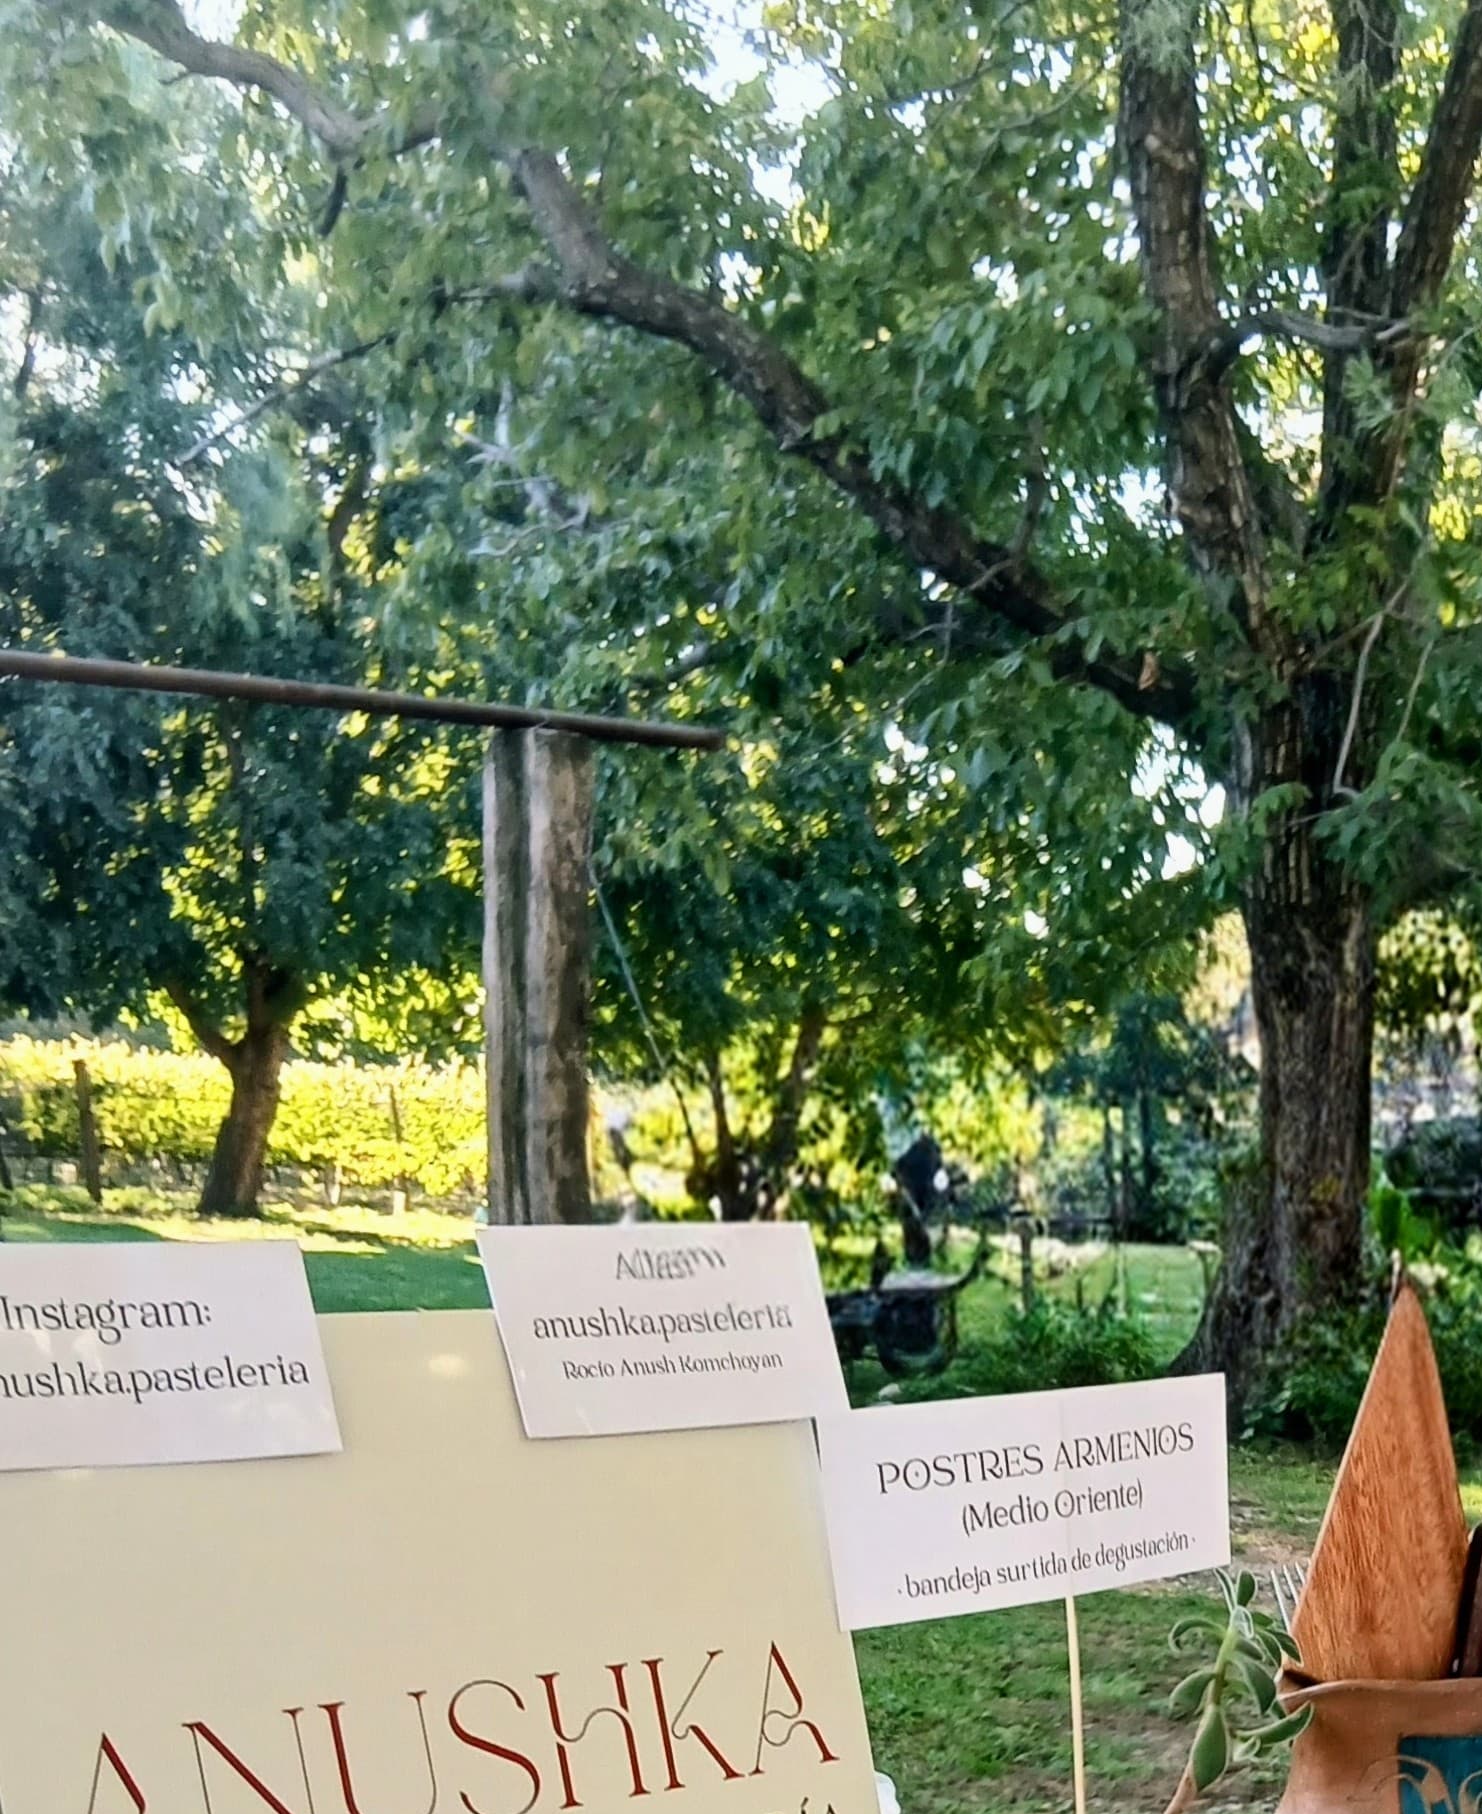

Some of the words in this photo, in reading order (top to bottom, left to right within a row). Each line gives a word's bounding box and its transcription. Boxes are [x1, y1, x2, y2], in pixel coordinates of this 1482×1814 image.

[0, 1295, 211, 1344] Instagram:
[620, 1354, 677, 1377] Anush
[875, 1443, 1044, 1495] POSTRES
[1053, 1422, 1195, 1473] ARMENIOS
[961, 1494, 1049, 1538] (Medio
[1055, 1477, 1144, 1520] Oriente)
[905, 1565, 992, 1599] bandeja
[997, 1551, 1069, 1585] surtida
[1071, 1547, 1092, 1573] de
[1095, 1531, 1190, 1573] degustación
